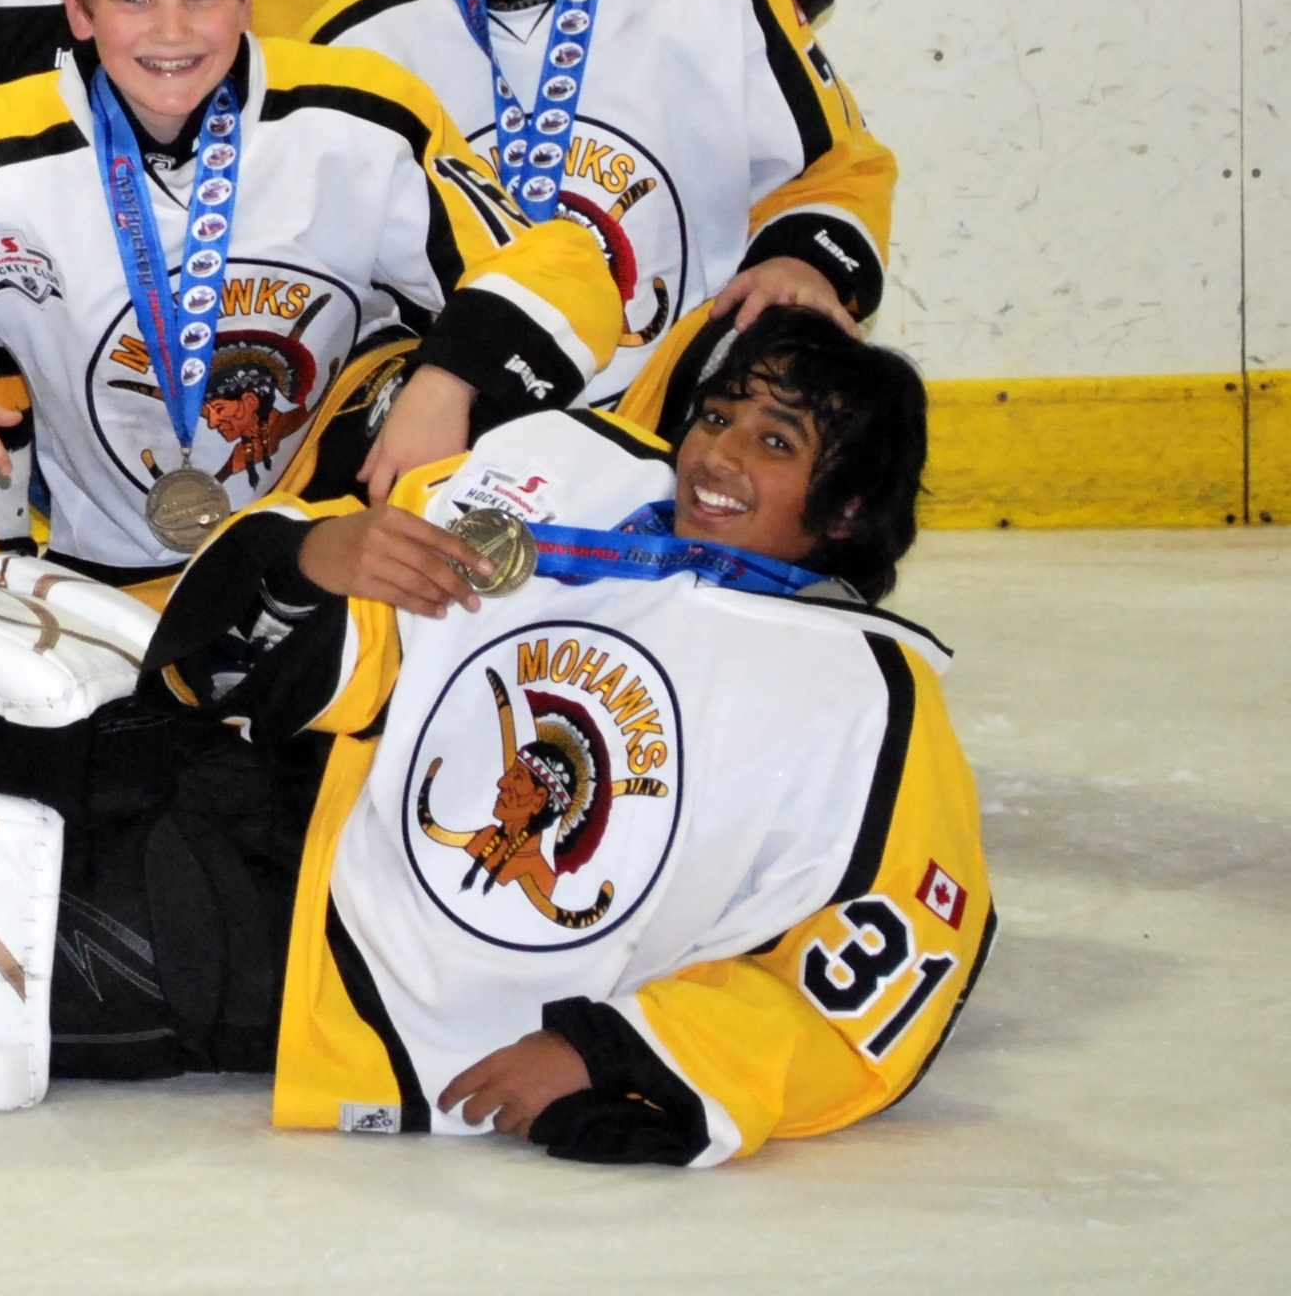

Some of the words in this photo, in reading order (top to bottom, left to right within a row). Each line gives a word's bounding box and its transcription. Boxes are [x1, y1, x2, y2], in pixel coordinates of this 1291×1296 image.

[33, 267, 60, 289] CLUB
[468, 487, 514, 515] HOCKEY
[516, 638, 668, 776] MOHAWKS
[799, 893, 960, 1064] 31
